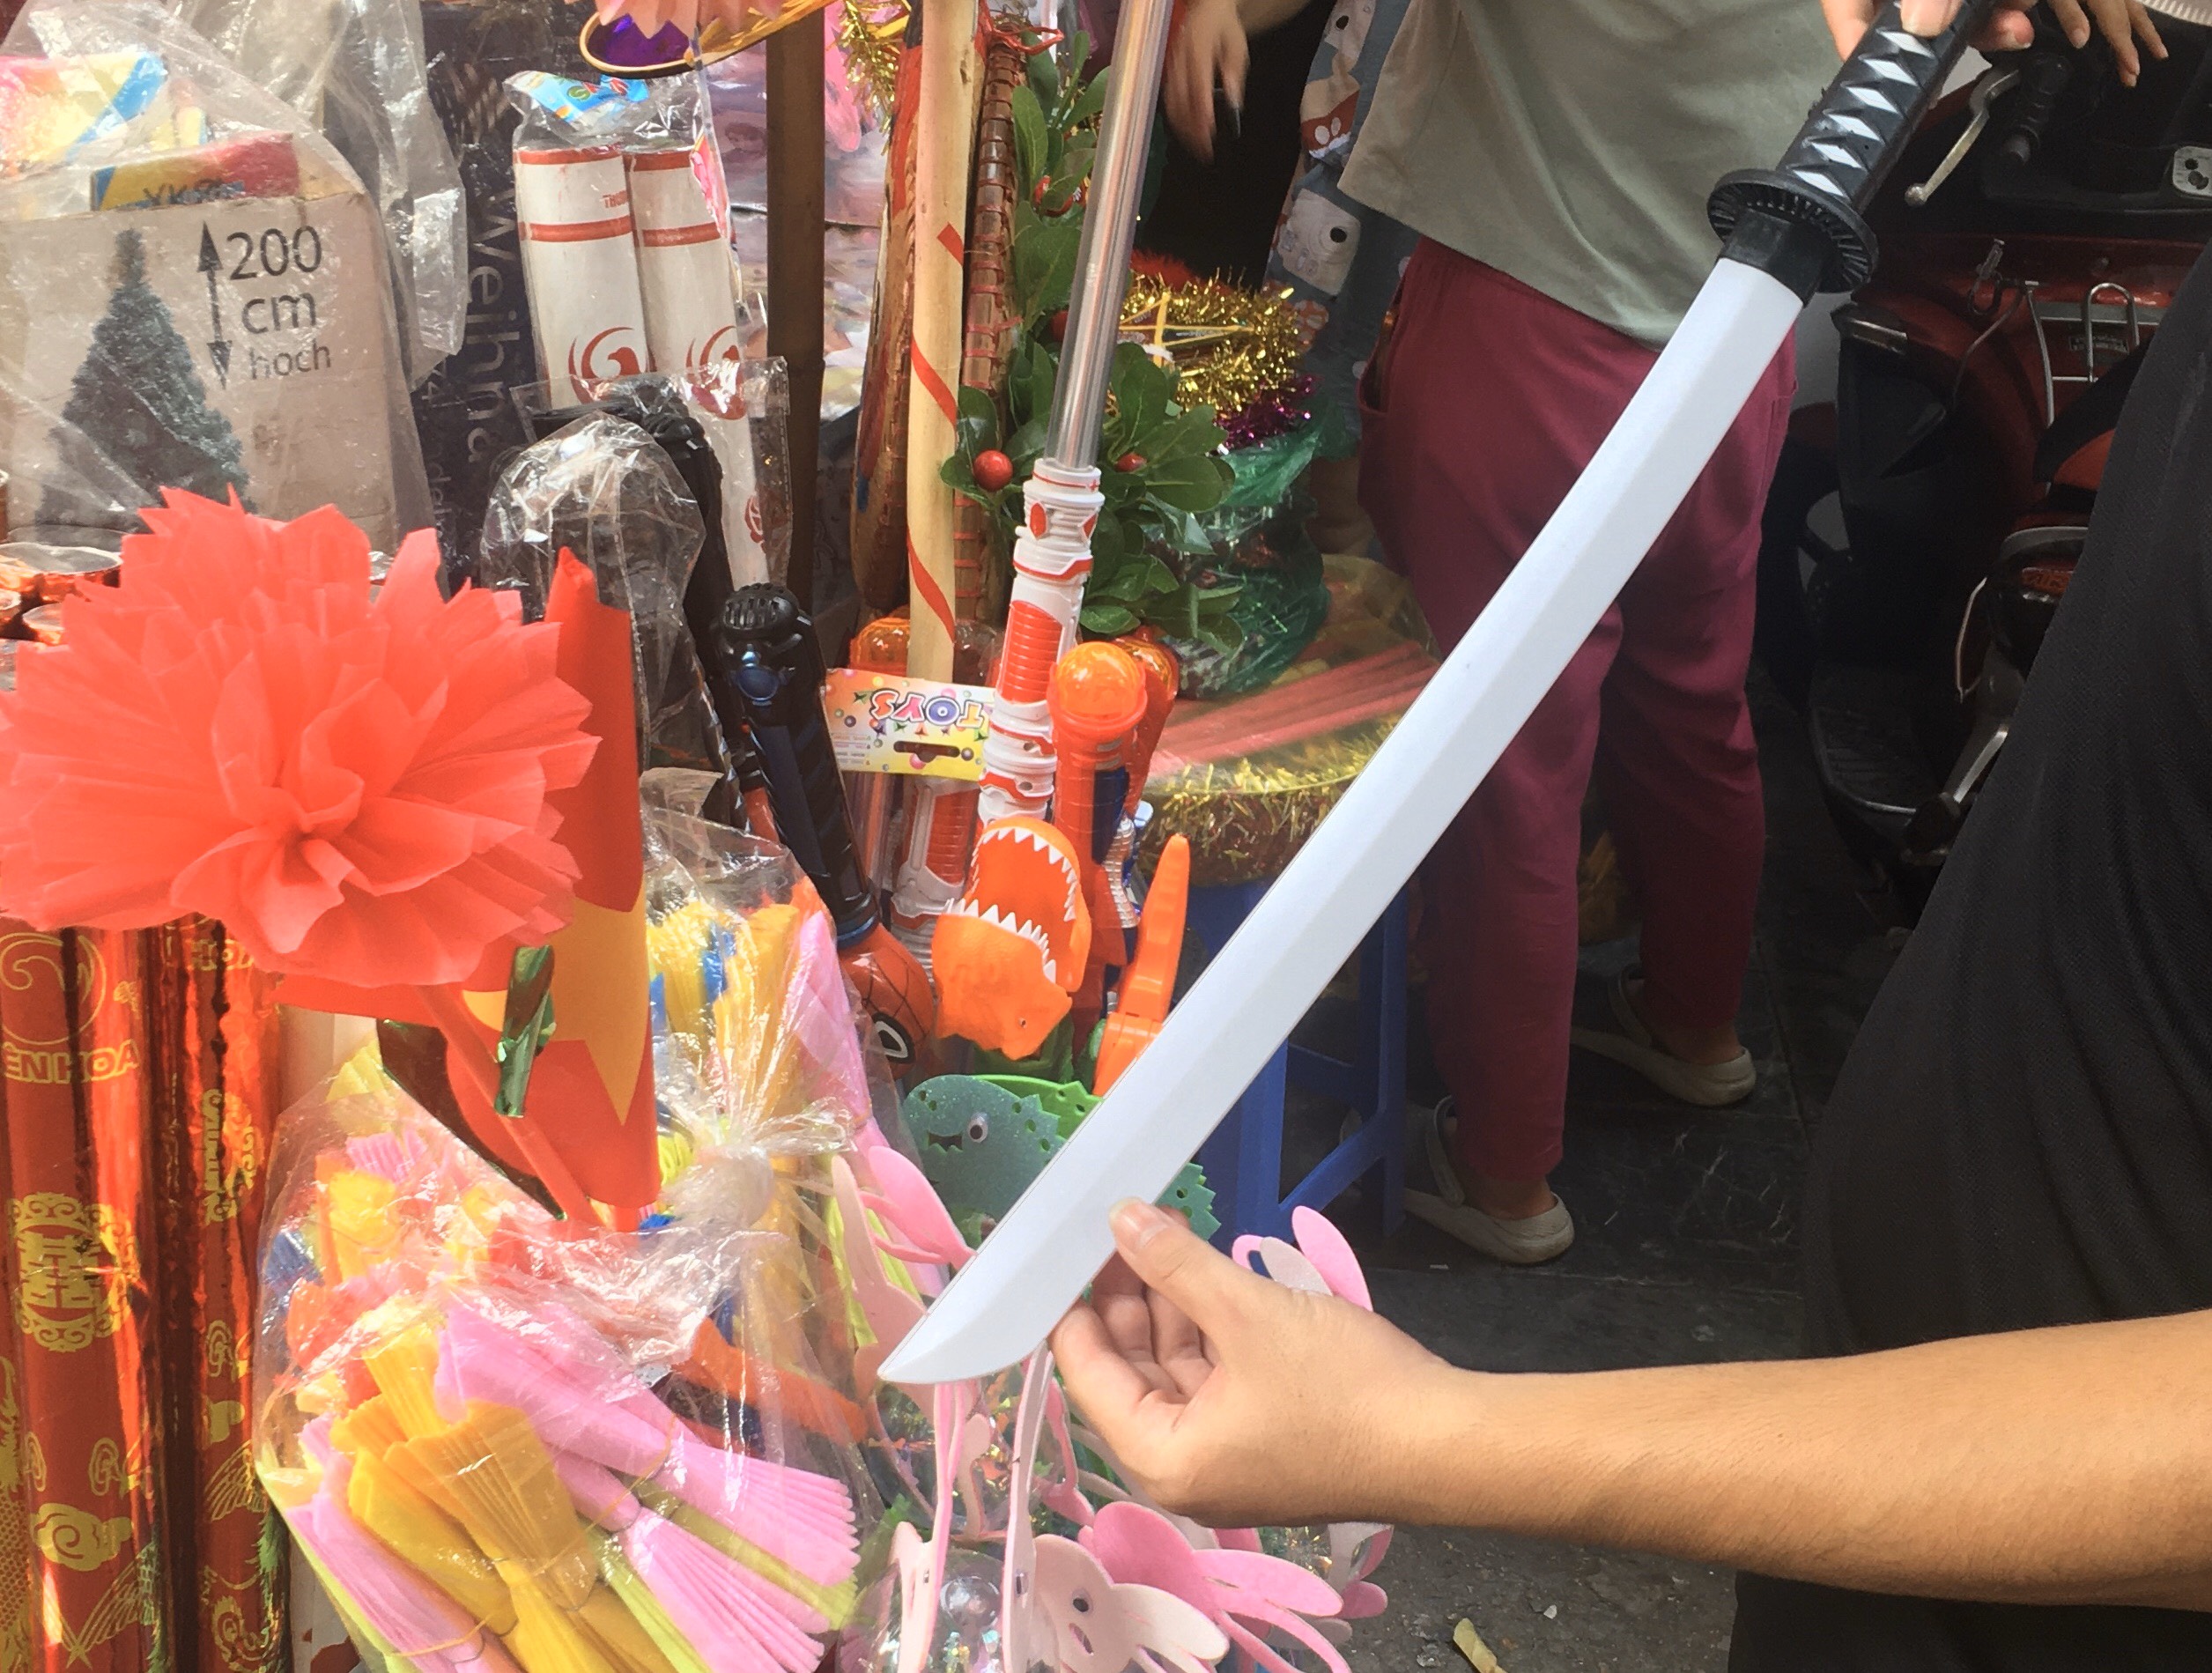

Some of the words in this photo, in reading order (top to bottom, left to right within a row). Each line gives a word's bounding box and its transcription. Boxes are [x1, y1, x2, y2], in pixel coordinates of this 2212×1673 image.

[226, 226, 322, 281] 200
[241, 292, 317, 335] cm
[248, 337, 332, 381] hoch
[869, 687, 985, 729] TOYS
